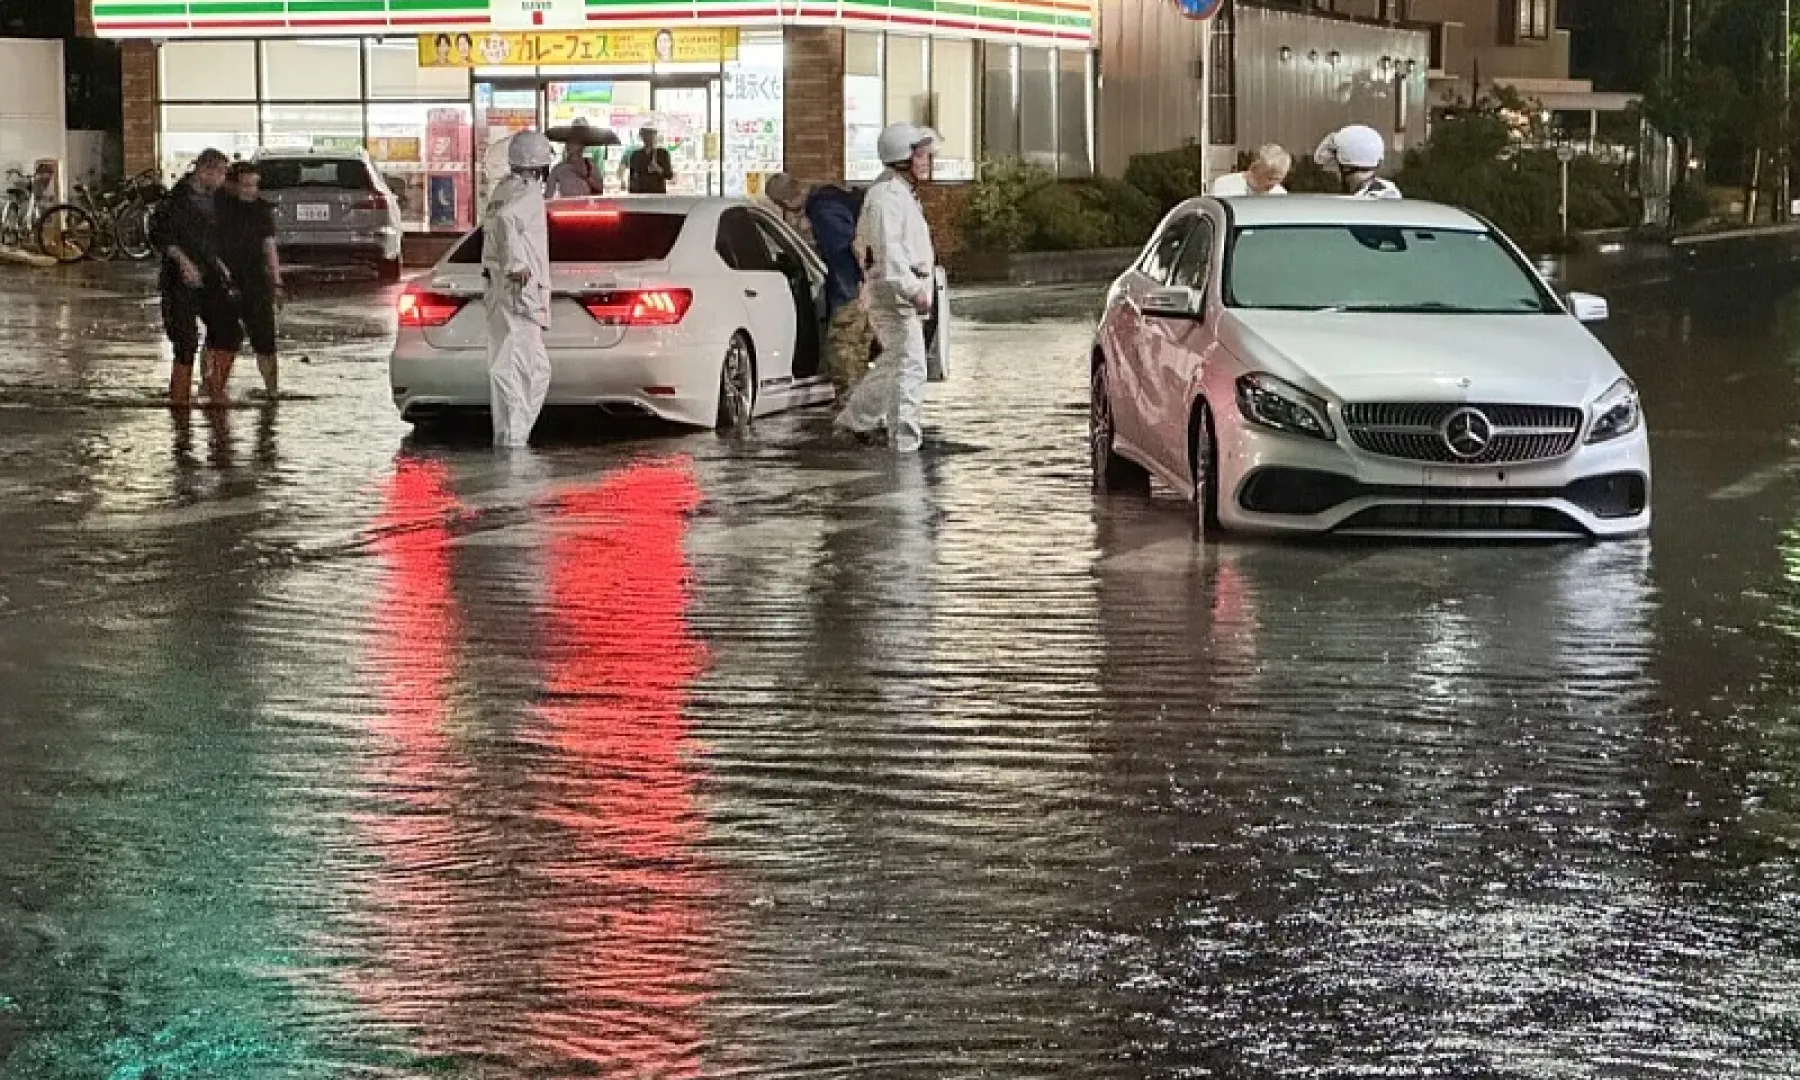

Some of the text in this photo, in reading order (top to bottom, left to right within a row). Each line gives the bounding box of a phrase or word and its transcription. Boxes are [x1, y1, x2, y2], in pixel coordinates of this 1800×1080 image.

[515, 32, 610, 61] カレーフェス
